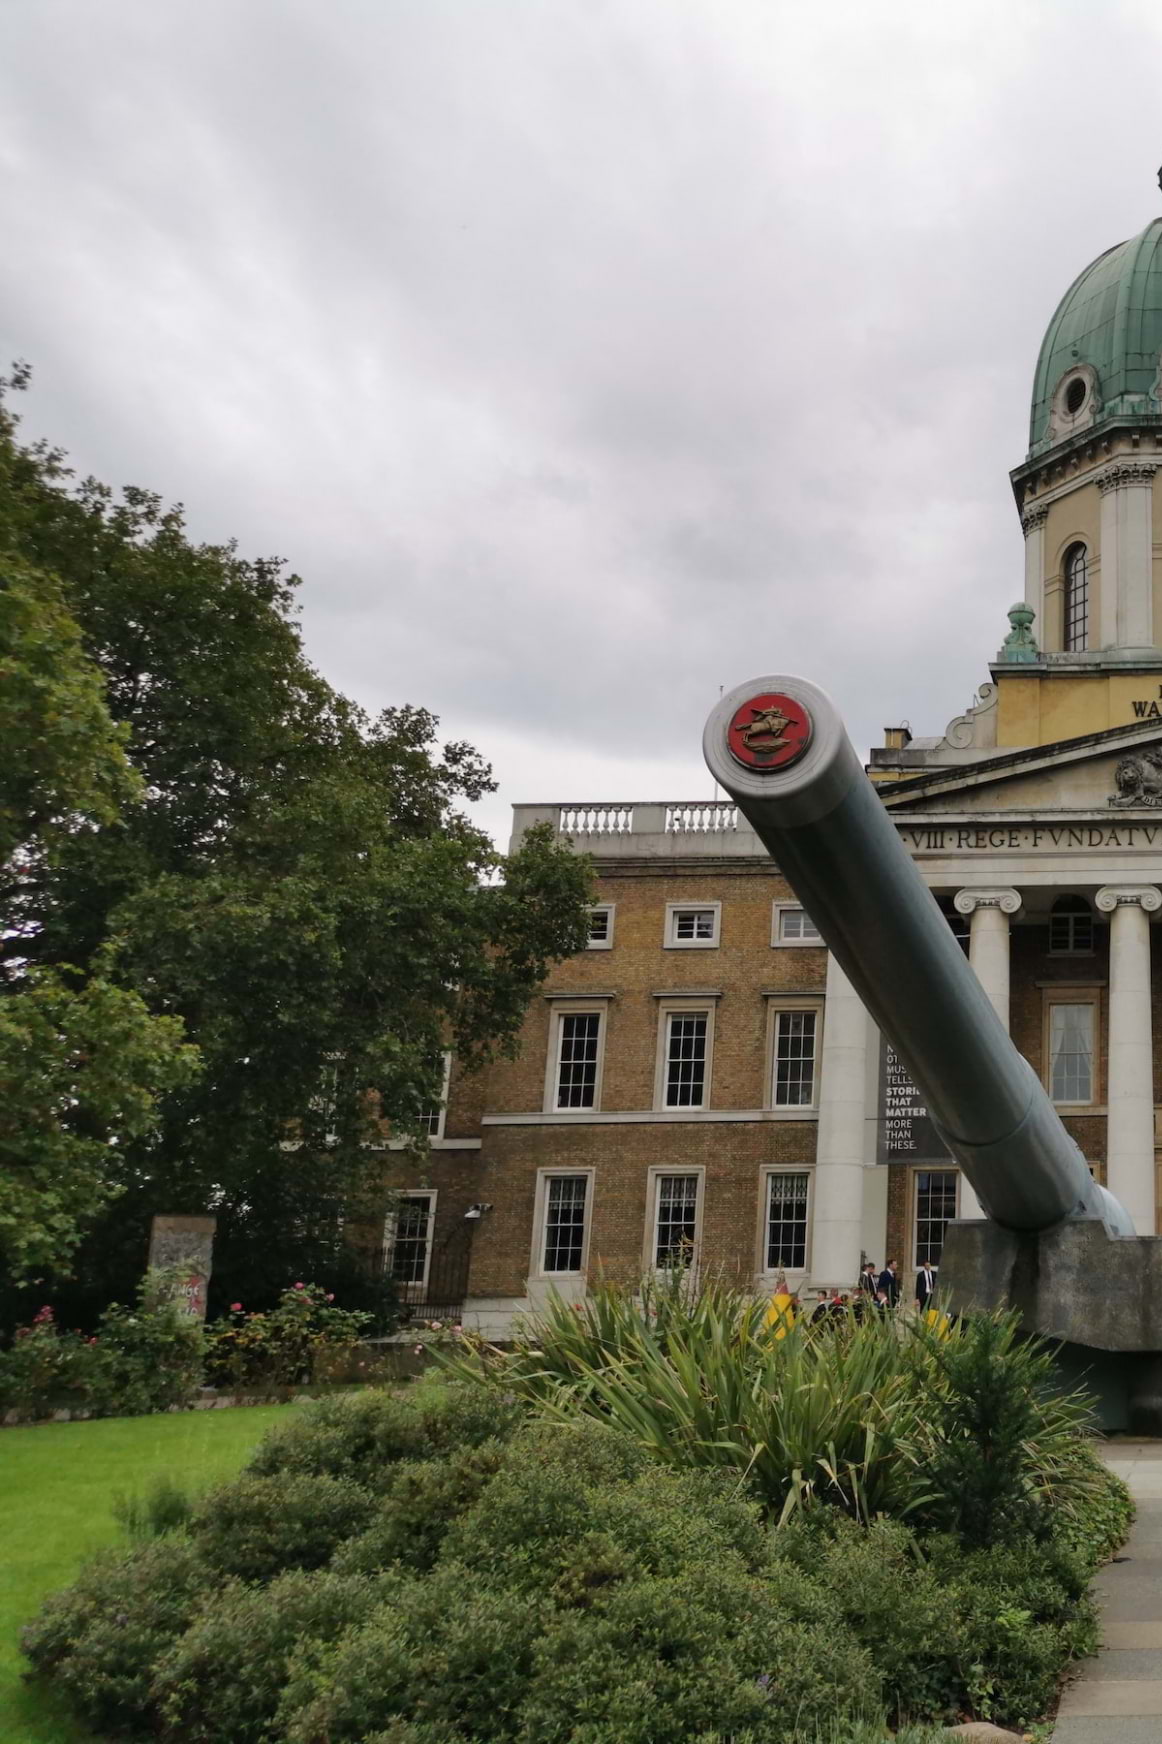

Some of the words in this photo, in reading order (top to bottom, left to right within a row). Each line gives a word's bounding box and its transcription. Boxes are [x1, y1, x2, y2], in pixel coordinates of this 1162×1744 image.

[909, 831, 945, 849] VIII
[956, 829, 1021, 849] REGE
[886, 1097, 912, 1106] THAT
[886, 1107, 926, 1117] MATTER
[885, 1119, 912, 1129] MORE
[885, 1130, 911, 1139] THAN
